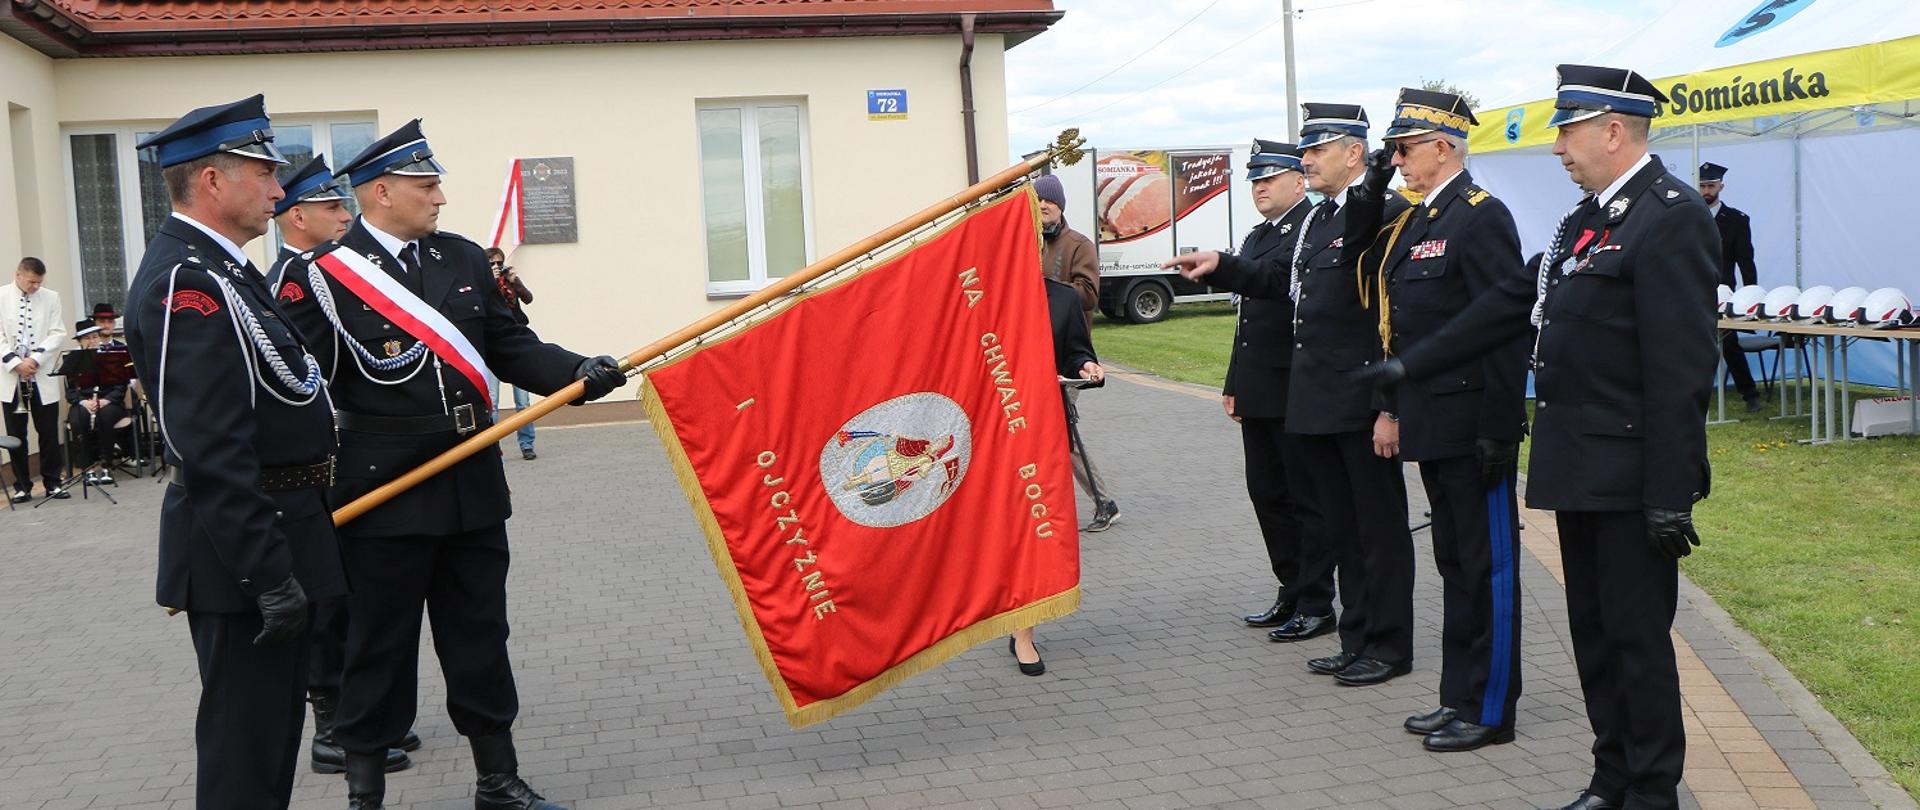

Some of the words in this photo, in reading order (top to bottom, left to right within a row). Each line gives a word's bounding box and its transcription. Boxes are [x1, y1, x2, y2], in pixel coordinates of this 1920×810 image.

[1670, 68, 1829, 115] Somianka
[878, 98, 897, 112] 72
[1190, 180, 1210, 193] smak
[736, 398, 755, 411] I
[959, 267, 984, 309] NA
[981, 332, 1026, 434] CHWAŁĘ
[1019, 463, 1053, 539] BOGU
